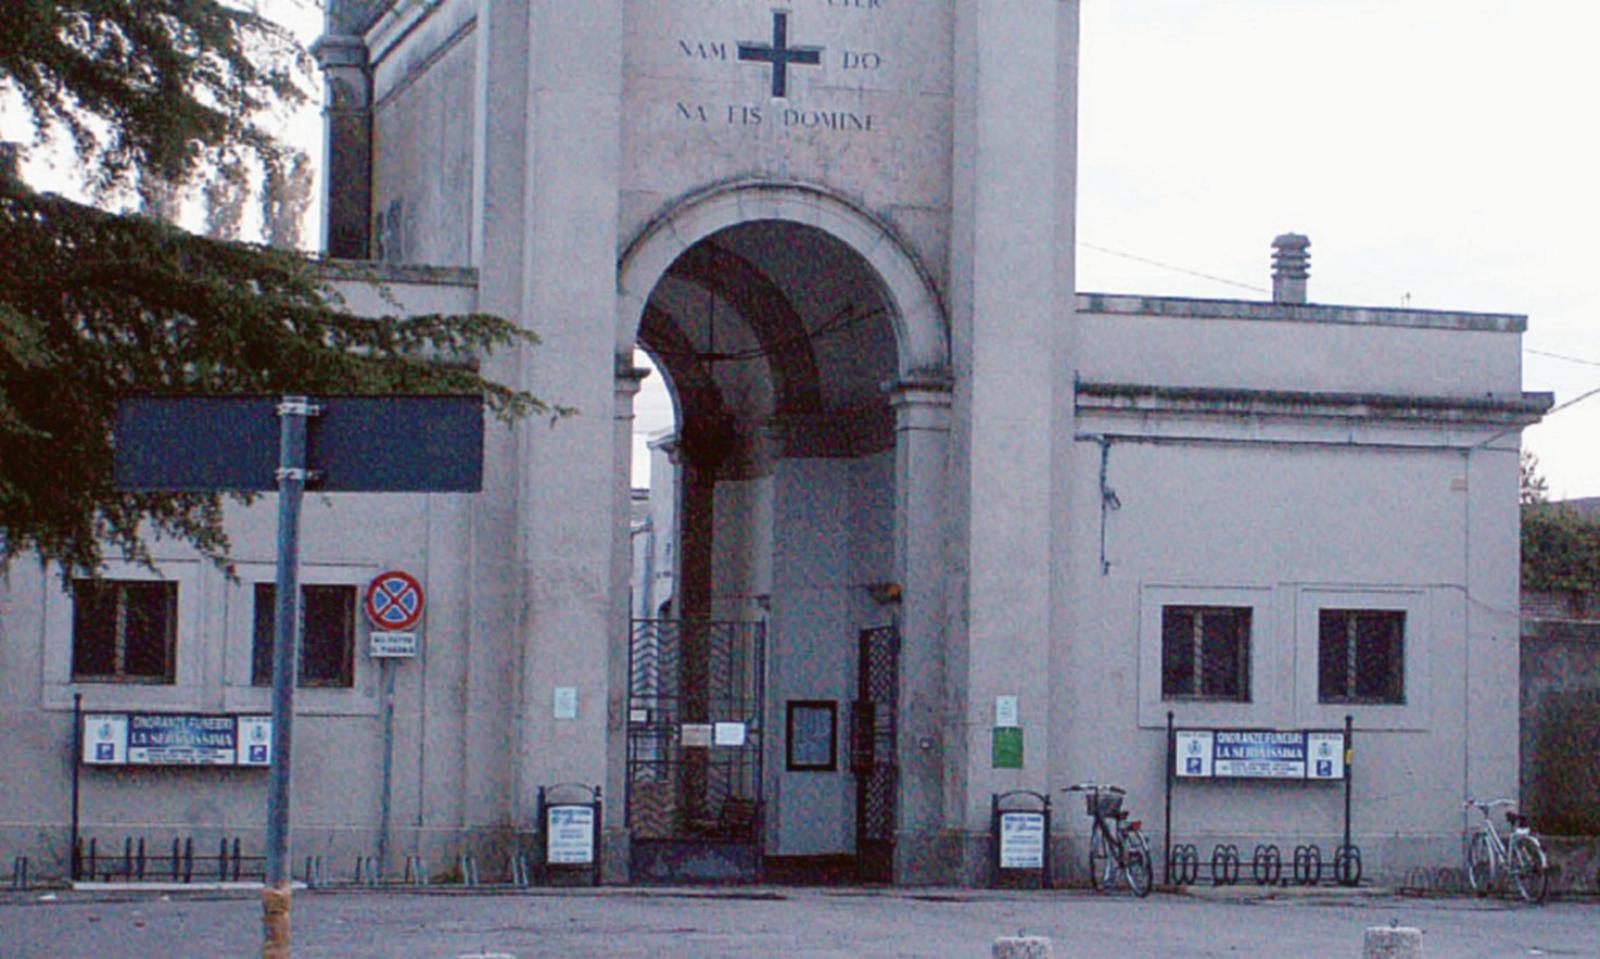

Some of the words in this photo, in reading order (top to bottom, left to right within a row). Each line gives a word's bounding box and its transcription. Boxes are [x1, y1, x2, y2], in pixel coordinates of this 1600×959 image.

[679, 40, 725, 61] NAM
[842, 51, 880, 70] DO
[783, 108, 876, 131] DOMINE
